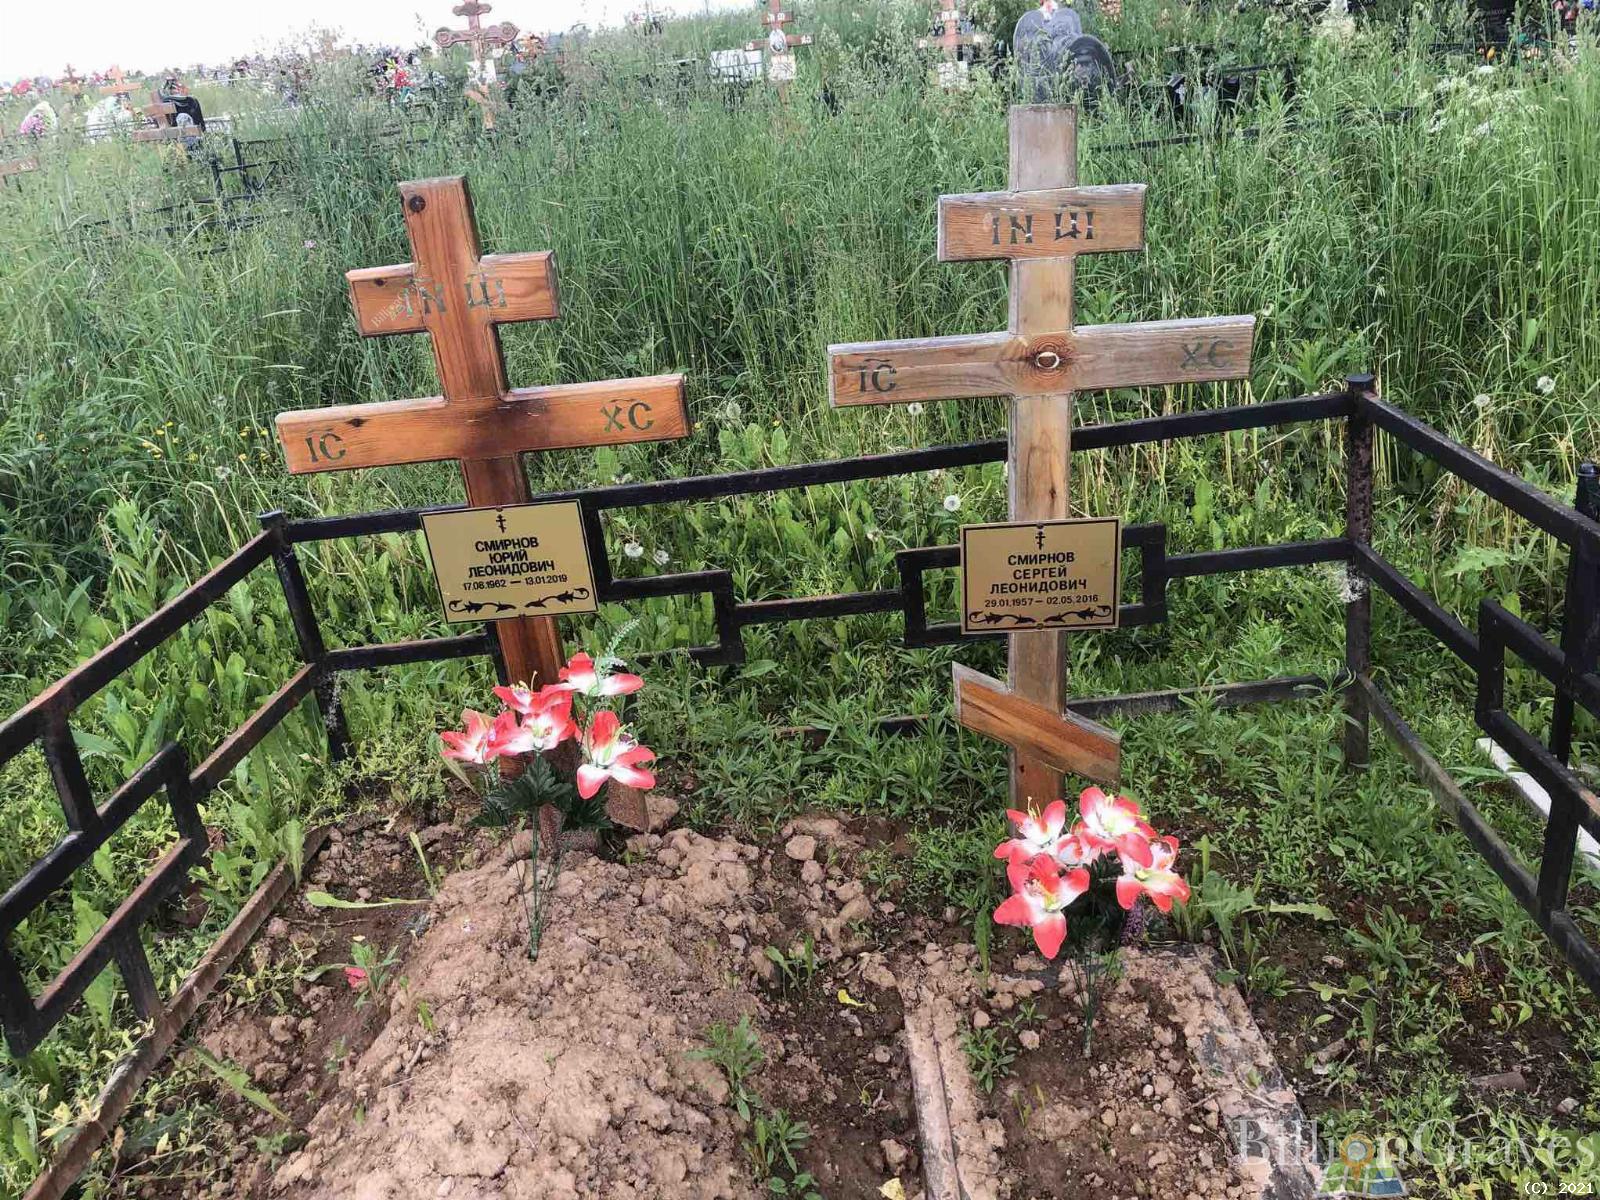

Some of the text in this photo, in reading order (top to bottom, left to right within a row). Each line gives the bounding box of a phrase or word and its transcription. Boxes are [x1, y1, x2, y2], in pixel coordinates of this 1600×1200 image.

[475, 537, 539, 552] СМИРНОВ
[489, 549, 528, 564] ЮРИЙ
[1008, 552, 1075, 566] СМИРНОВ
[468, 560, 555, 579] ЛЕОНИДОВИЧ
[1013, 565, 1067, 580] СЕРГЕЙ
[525, 575, 568, 586] 13.01.2019
[990, 579, 1087, 594] ЛЕОНИДОВИЧ
[985, 597, 1033, 608] 29.01.1957
[1046, 594, 1099, 606] 02.05.2016
